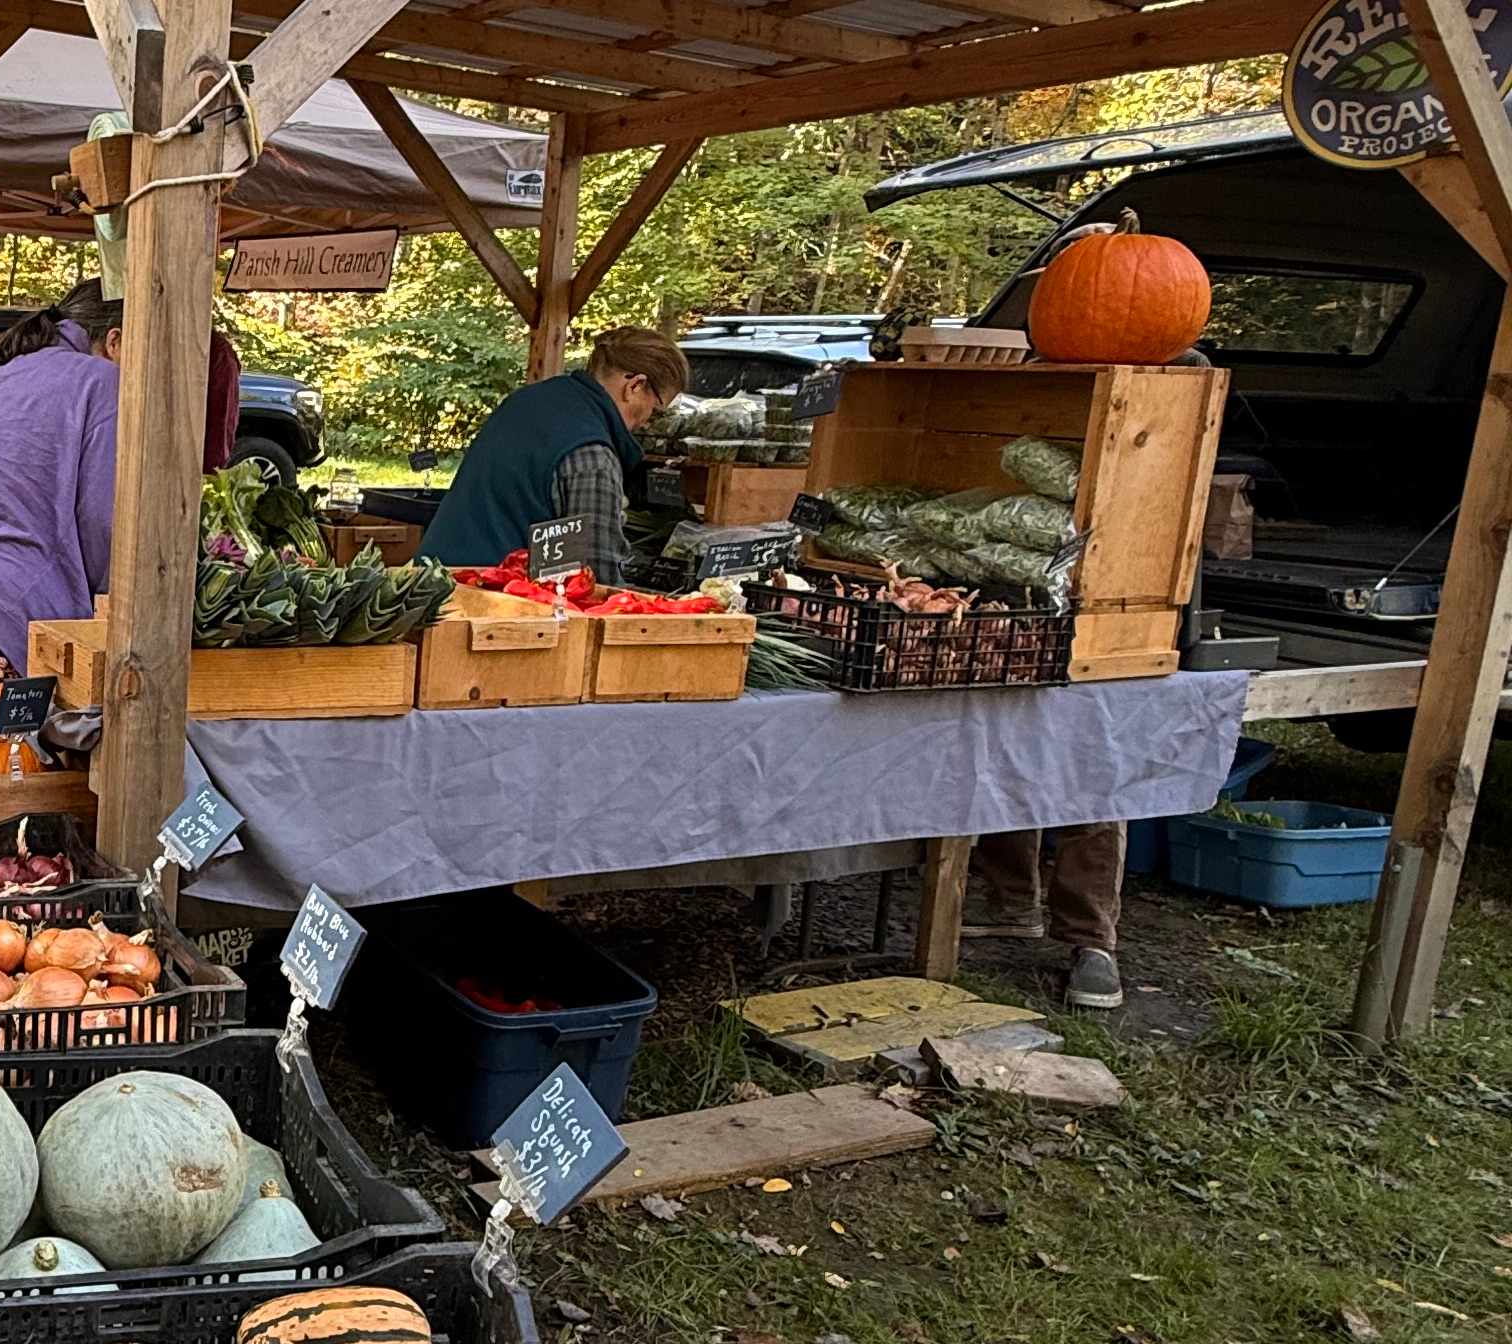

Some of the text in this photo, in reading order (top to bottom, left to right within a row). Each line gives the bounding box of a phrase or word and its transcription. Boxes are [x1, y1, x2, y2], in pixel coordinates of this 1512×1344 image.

[1338, 117, 1452, 156] PROJEC
[234, 245, 391, 279] Parish Hill Creamery
[543, 541, 565, 560] $5
[300, 913, 338, 961] Hubbard
